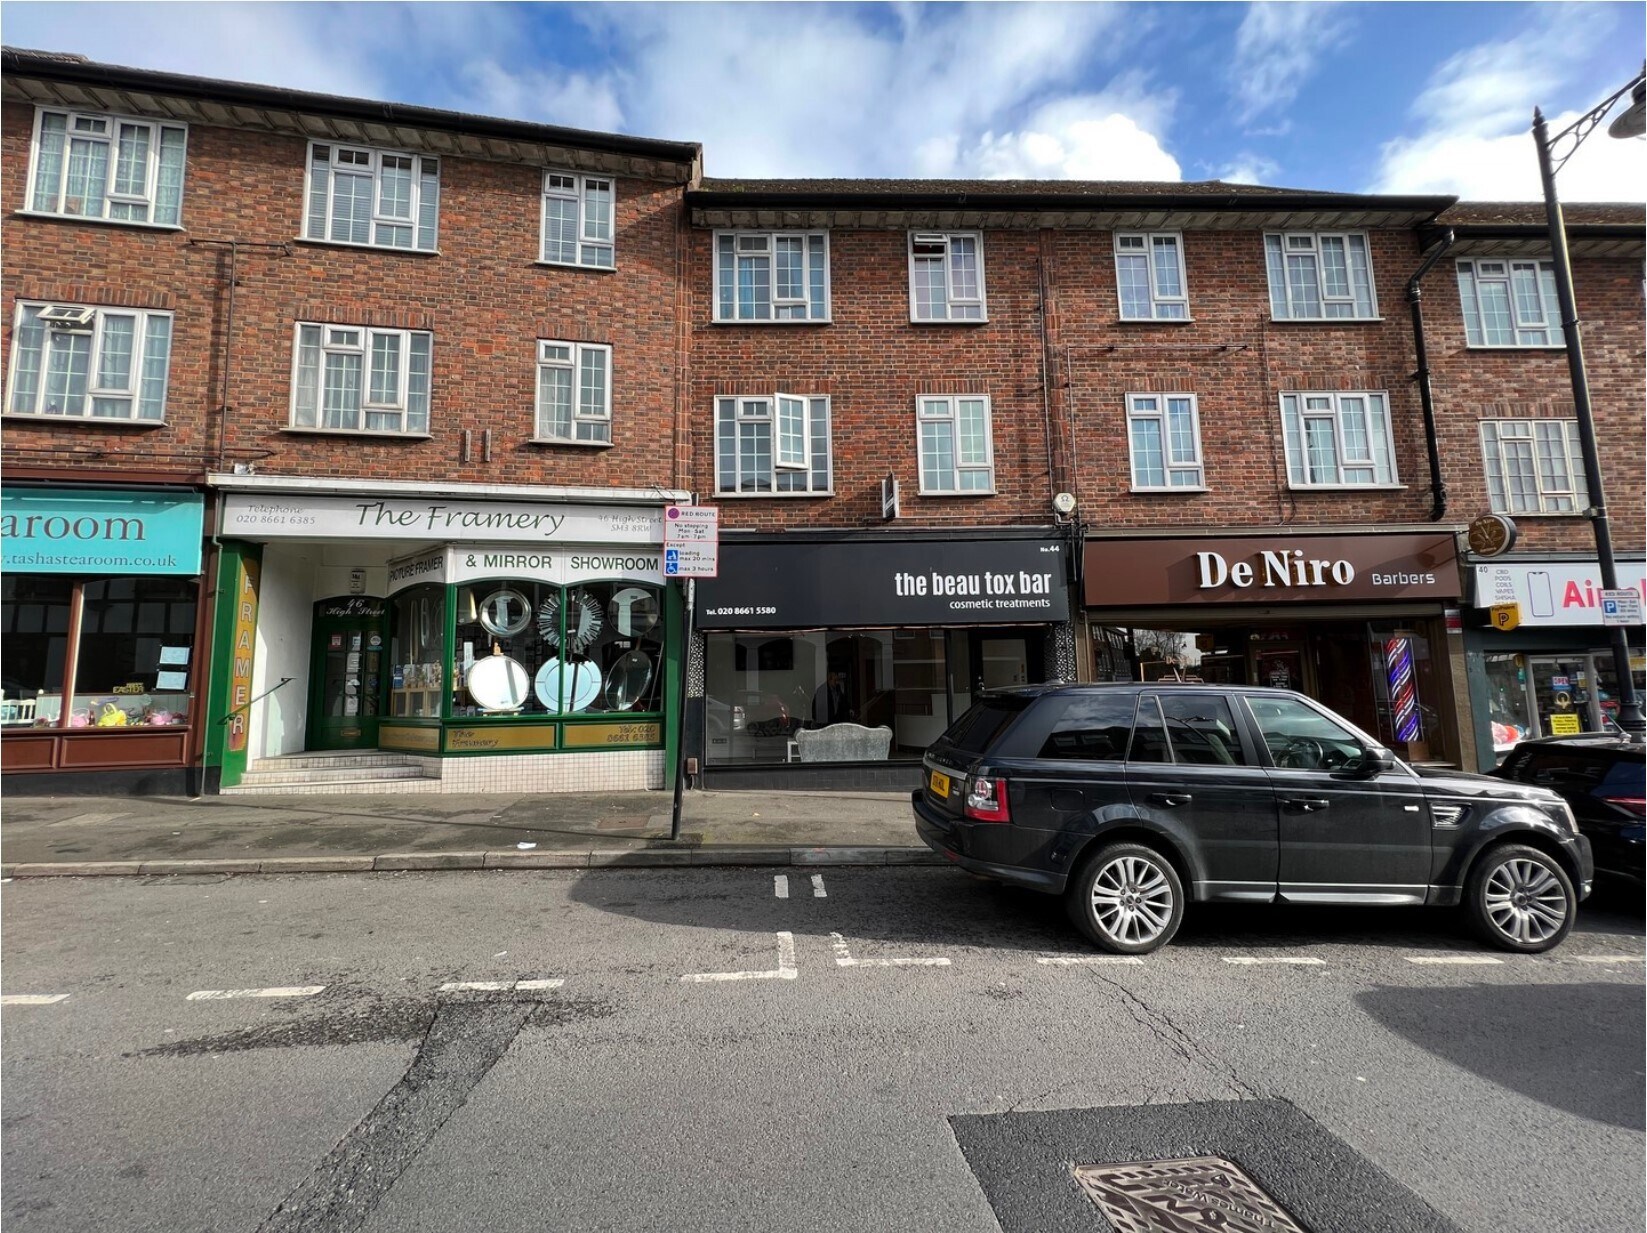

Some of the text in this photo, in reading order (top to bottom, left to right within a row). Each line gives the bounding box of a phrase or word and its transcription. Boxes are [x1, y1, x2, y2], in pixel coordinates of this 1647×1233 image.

[247, 504, 304, 515] Telephone
[236, 515, 316, 525] 020 8661 6385
[356, 501, 565, 536] The Framery
[610, 523, 629, 532] SM3
[415, 556, 444, 575] FRAMER
[465, 554, 552, 569] & MIRROR
[570, 556, 659, 571] SHOWROOM
[1196, 549, 1356, 589] De Niro
[1478, 565, 1488, 573] 40
[894, 571, 1052, 597] the beau tox bar
[1372, 571, 1436, 586] Barbers
[346, 599, 365, 608] 46
[717, 607, 733, 615] 020
[734, 607, 754, 615] 8661
[755, 606, 777, 615] 5580
[949, 598, 1051, 609] cosmetic treatments
[325, 607, 386, 617] High Street
[232, 574, 253, 735] FRAMER
[1161, 1179, 1276, 1229] Thames Water
